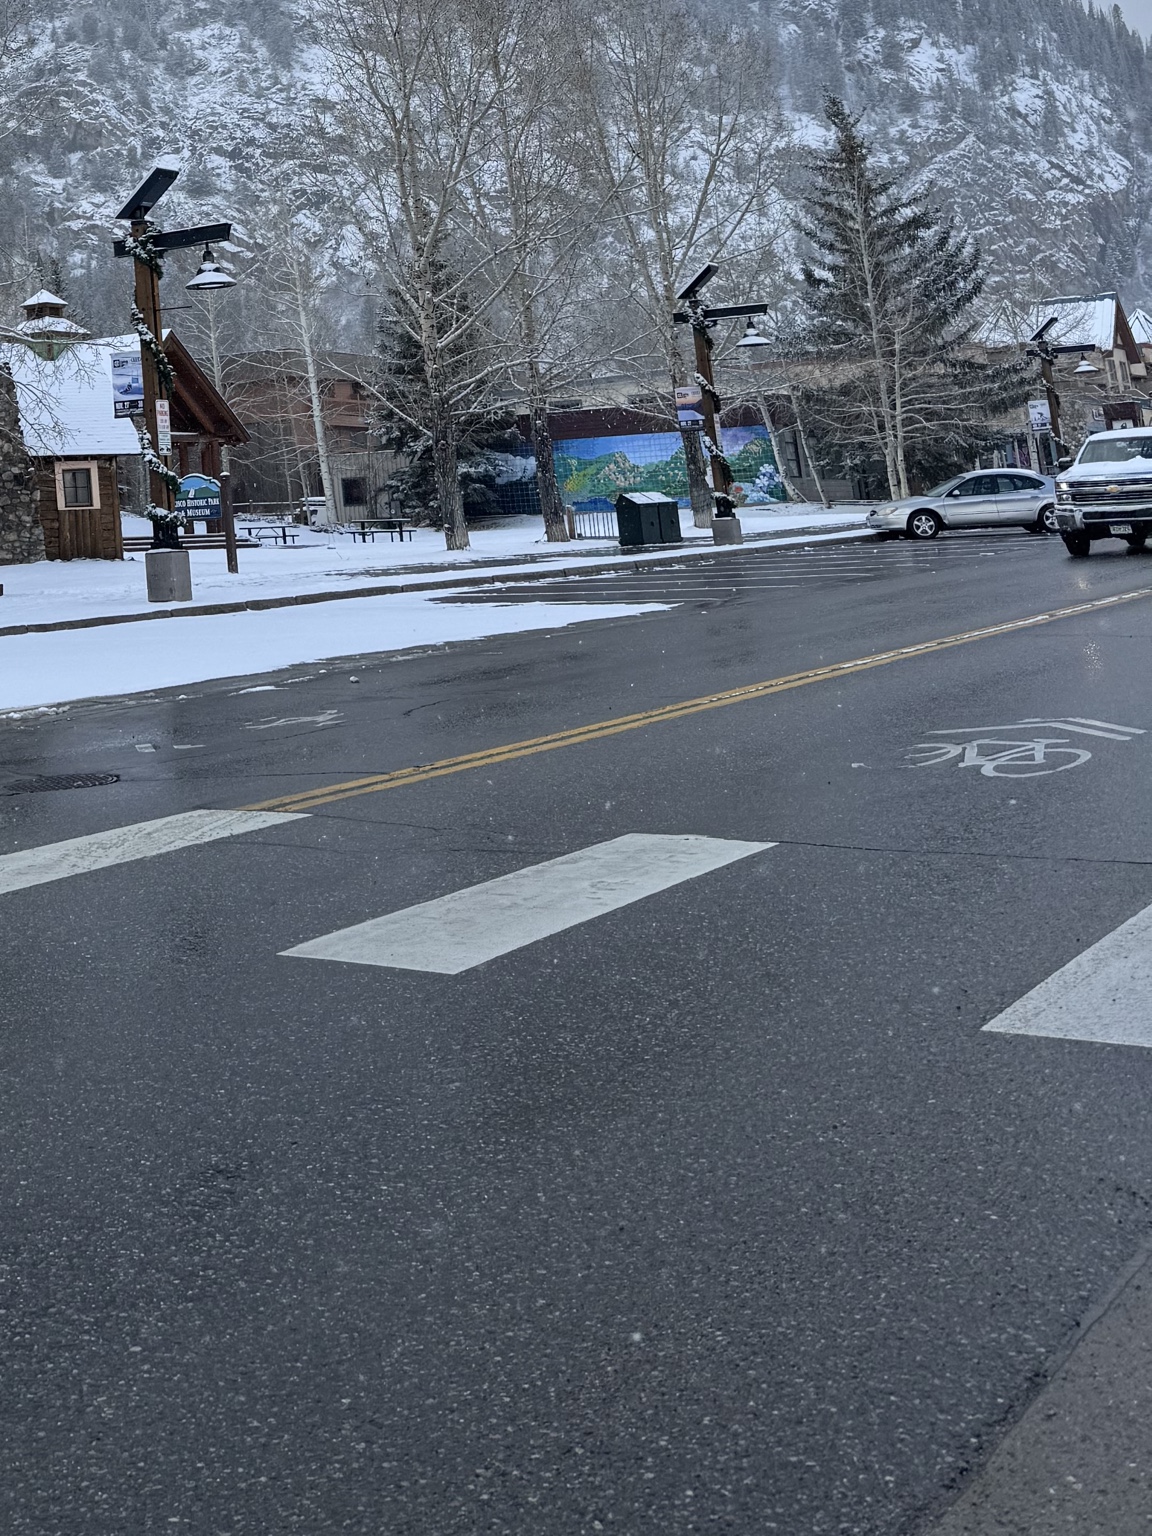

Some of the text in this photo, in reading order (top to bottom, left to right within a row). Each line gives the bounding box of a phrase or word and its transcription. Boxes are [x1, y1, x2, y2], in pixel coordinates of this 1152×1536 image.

[186, 498, 208, 507] HISTORIC
[207, 497, 220, 506] PARK
[186, 508, 211, 517] MUSEUM
